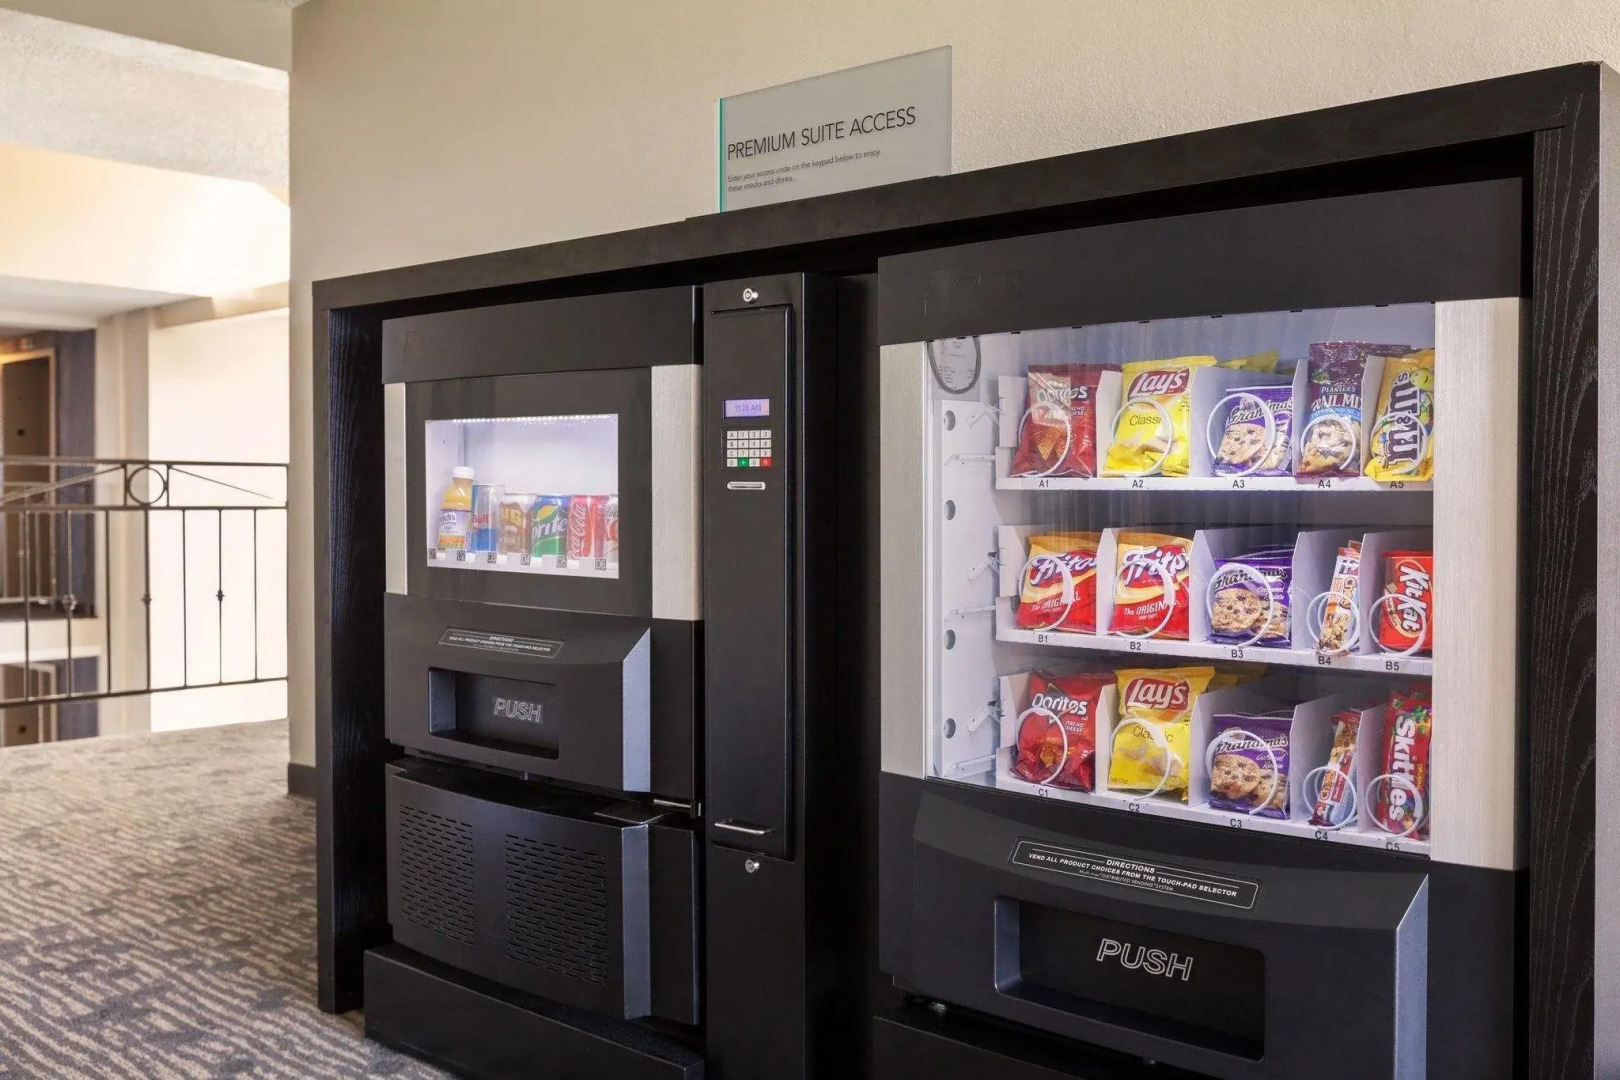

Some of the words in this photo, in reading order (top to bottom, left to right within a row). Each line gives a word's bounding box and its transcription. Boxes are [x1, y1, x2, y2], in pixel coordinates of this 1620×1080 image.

[727, 131, 796, 160] PREMIUM
[801, 121, 845, 146] SUITE
[849, 106, 916, 137] ACCESS
[744, 173, 755, 181] your
[757, 169, 775, 177] access
[776, 164, 790, 173] code
[801, 161, 811, 169] the
[812, 156, 833, 168] keypad
[835, 154, 854, 163] below
[855, 152, 862, 160] to
[864, 149, 880, 158] enjoy
[744, 180, 762, 189] snacks
[1130, 370, 1189, 398] Lay's
[1129, 414, 1162, 427] Classi
[1038, 480, 1049, 488] A1
[1132, 479, 1143, 488] A2
[1232, 480, 1245, 488] A3
[1317, 479, 1331, 488] A4
[1389, 481, 1404, 489] A5
[531, 511, 567, 540] prite
[1038, 635, 1048, 643] B1
[1130, 641, 1142, 650] B2
[1231, 650, 1244, 659] B3
[1318, 656, 1331, 666] B4
[1385, 661, 1400, 671] B5
[1126, 679, 1188, 710] Lay's
[1031, 692, 1088, 715] Doritos
[493, 697, 542, 723] PUSH
[1038, 788, 1049, 797] C1
[1128, 802, 1140, 812] C2
[1230, 818, 1243, 828] C3
[1315, 831, 1328, 841] C4
[1385, 841, 1400, 851] C5
[1106, 859, 1155, 874] DIRECTIONS
[1028, 853, 1046, 861] VEND
[1060, 858, 1090, 868] PRODUCT
[1091, 864, 1121, 875] CHOICES
[1121, 870, 1141, 879] FROM
[1158, 877, 1197, 890] TOUCH-PAD
[1198, 884, 1238, 897] SELECTOR
[1096, 938, 1193, 981] PUSH
